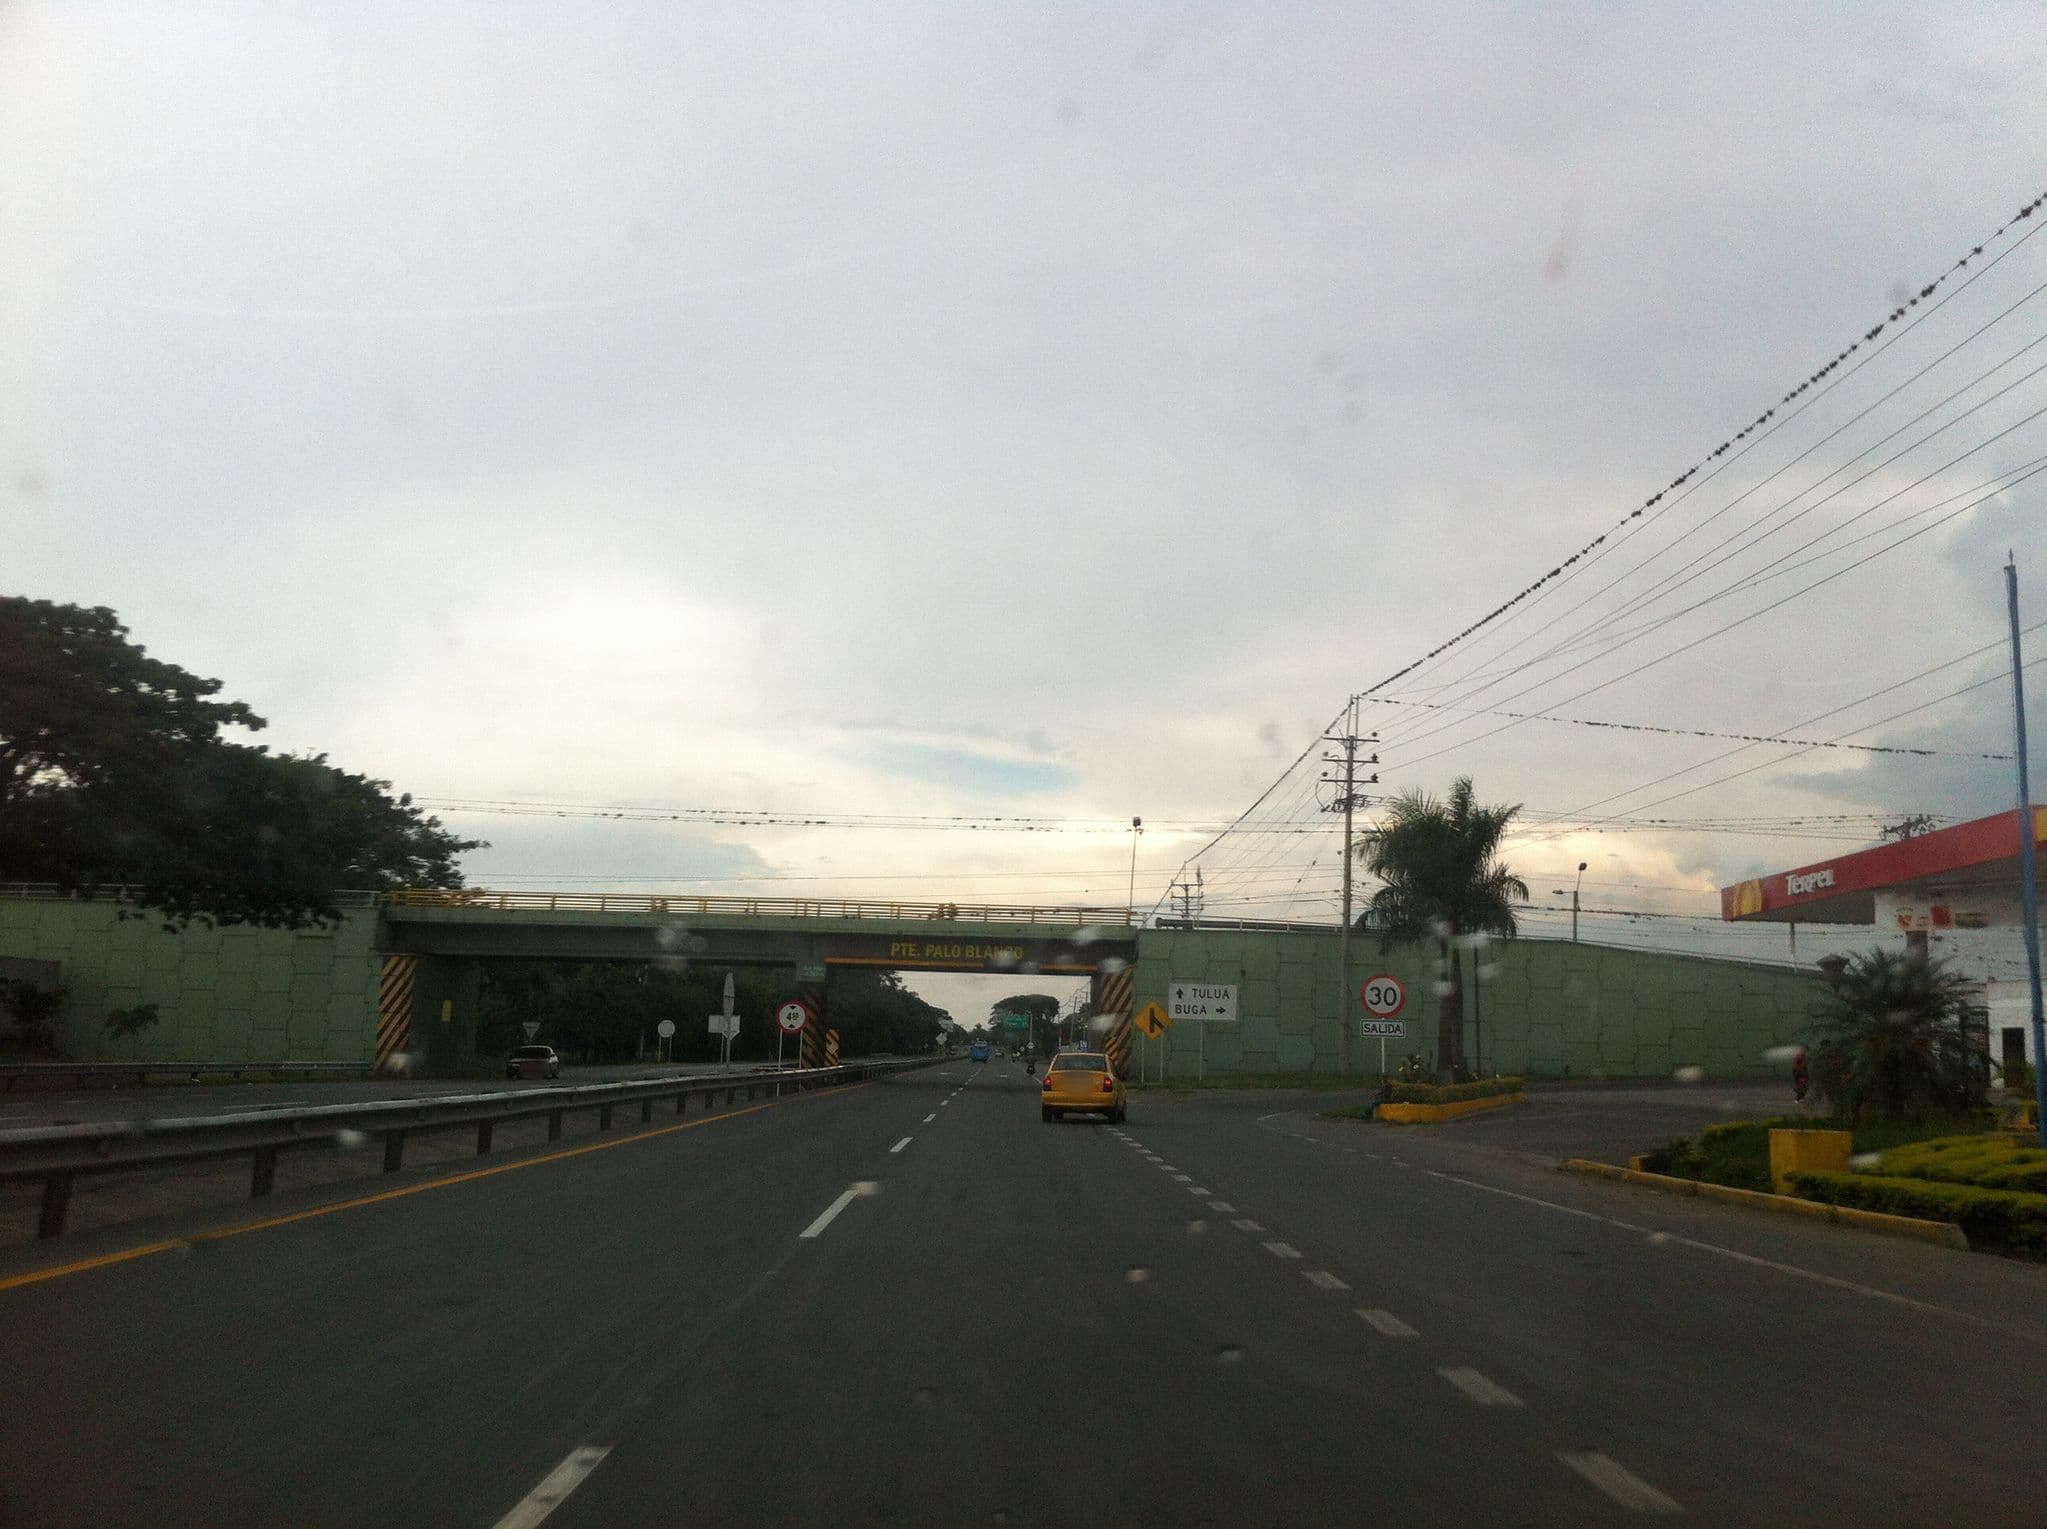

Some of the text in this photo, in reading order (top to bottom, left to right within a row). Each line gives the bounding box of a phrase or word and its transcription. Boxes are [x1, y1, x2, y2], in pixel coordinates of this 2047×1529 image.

[925, 944, 961, 958] PALO
[1368, 986, 1397, 1006] 30
[1175, 1003, 1207, 1015] BUGA
[1364, 1023, 1402, 1034] SALIDA
